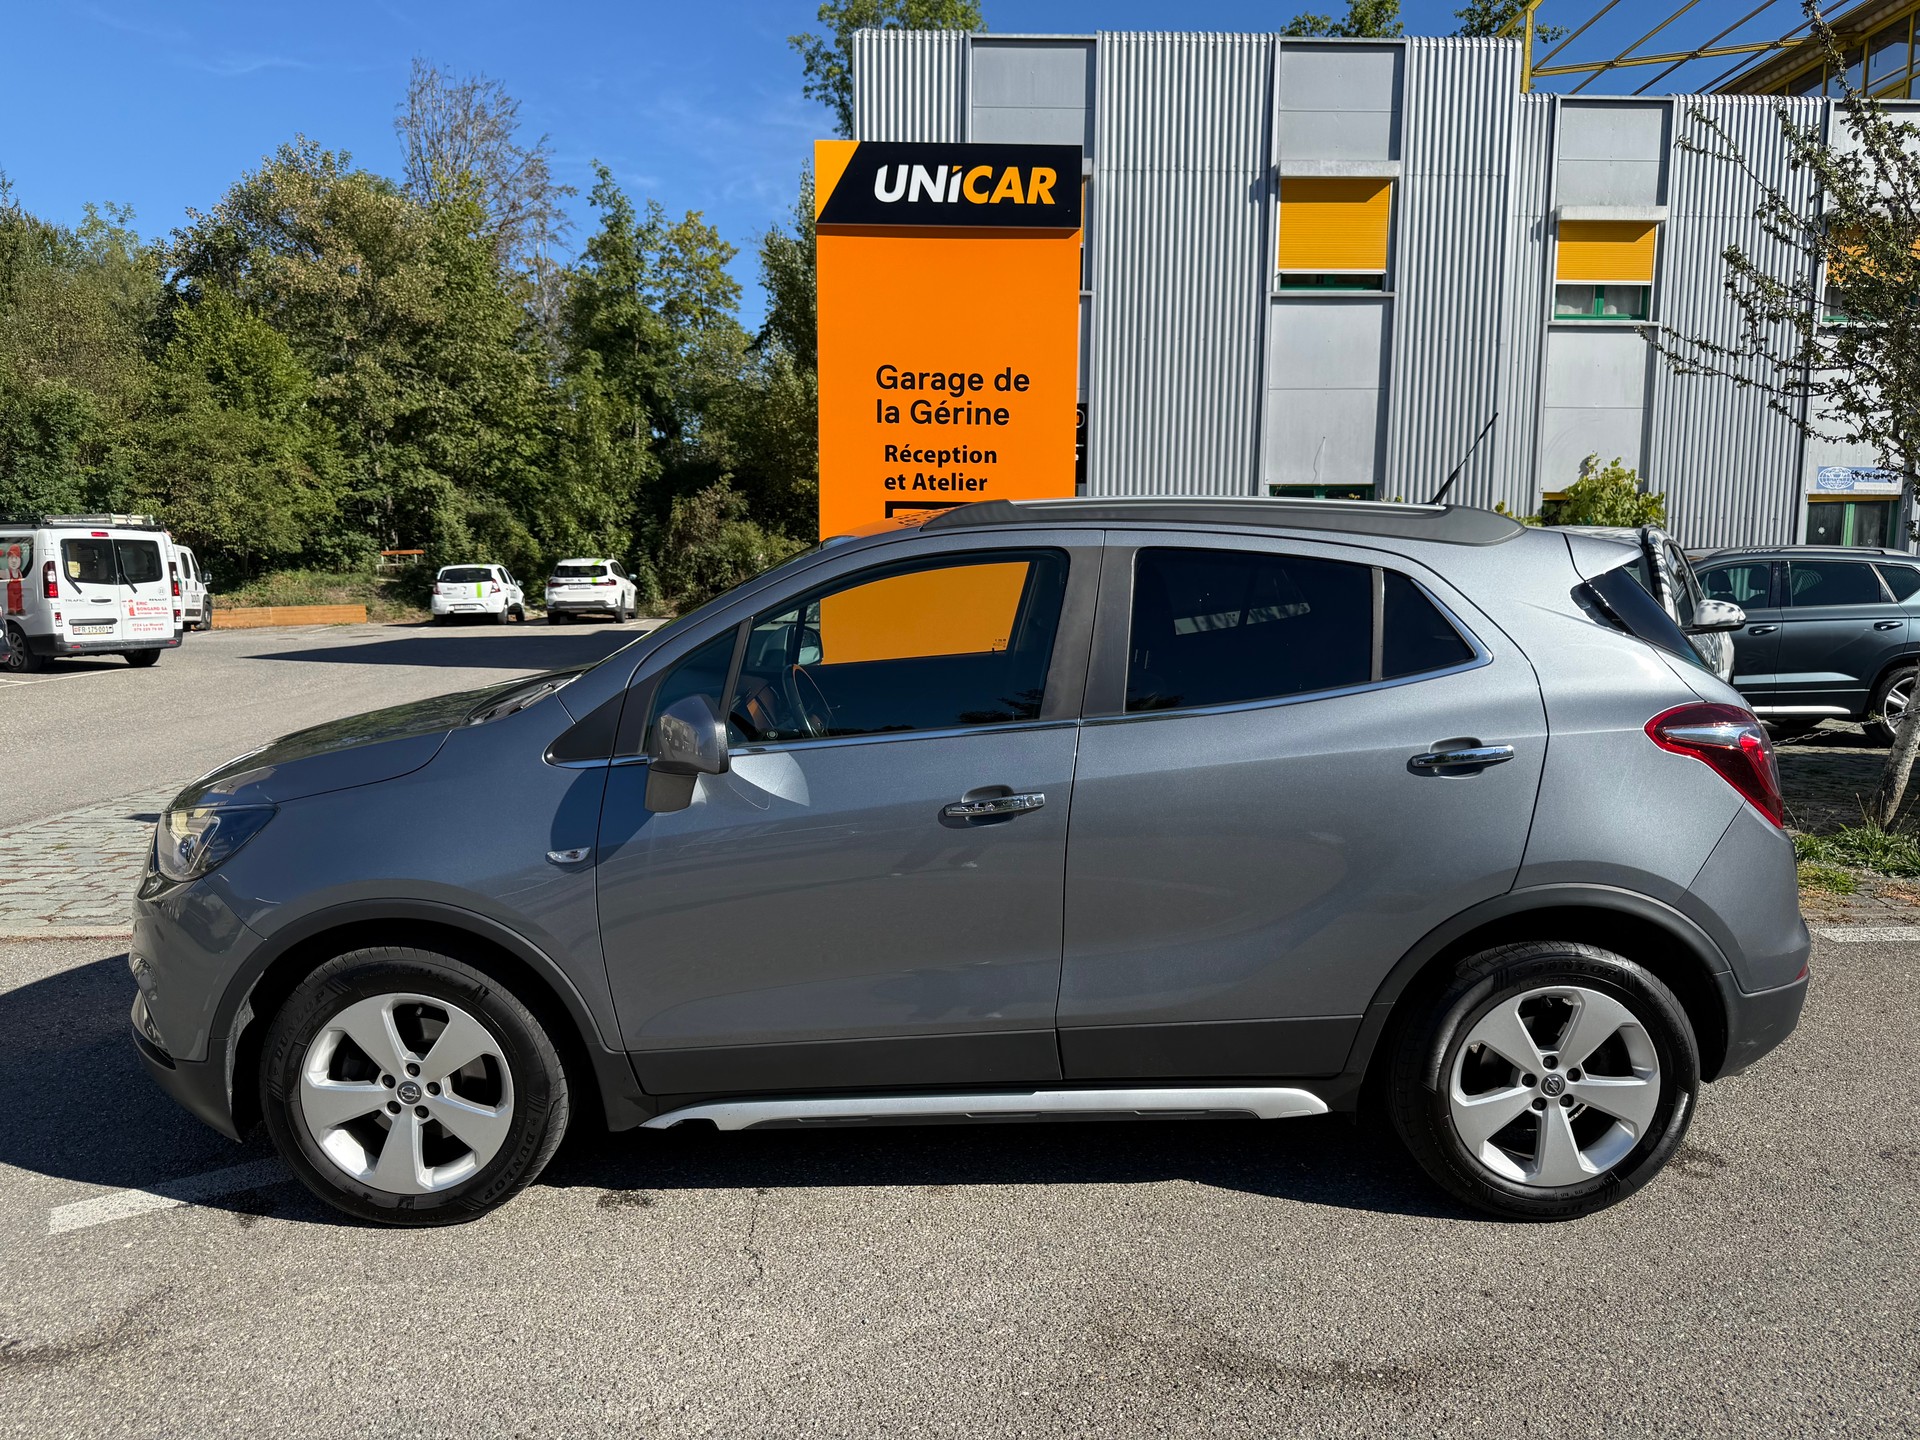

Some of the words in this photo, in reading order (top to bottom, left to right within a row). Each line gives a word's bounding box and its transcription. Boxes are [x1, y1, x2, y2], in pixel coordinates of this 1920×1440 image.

[875, 364, 984, 398] Garage
[993, 366, 1030, 392] de
[876, 398, 900, 424] la
[910, 399, 1010, 426] Gérine
[884, 443, 997, 468] Réception
[884, 473, 906, 491] et
[912, 472, 988, 492] Atelier
[1530, 959, 1618, 977] DUNLOP
[484, 1131, 537, 1201] DUNLOP
